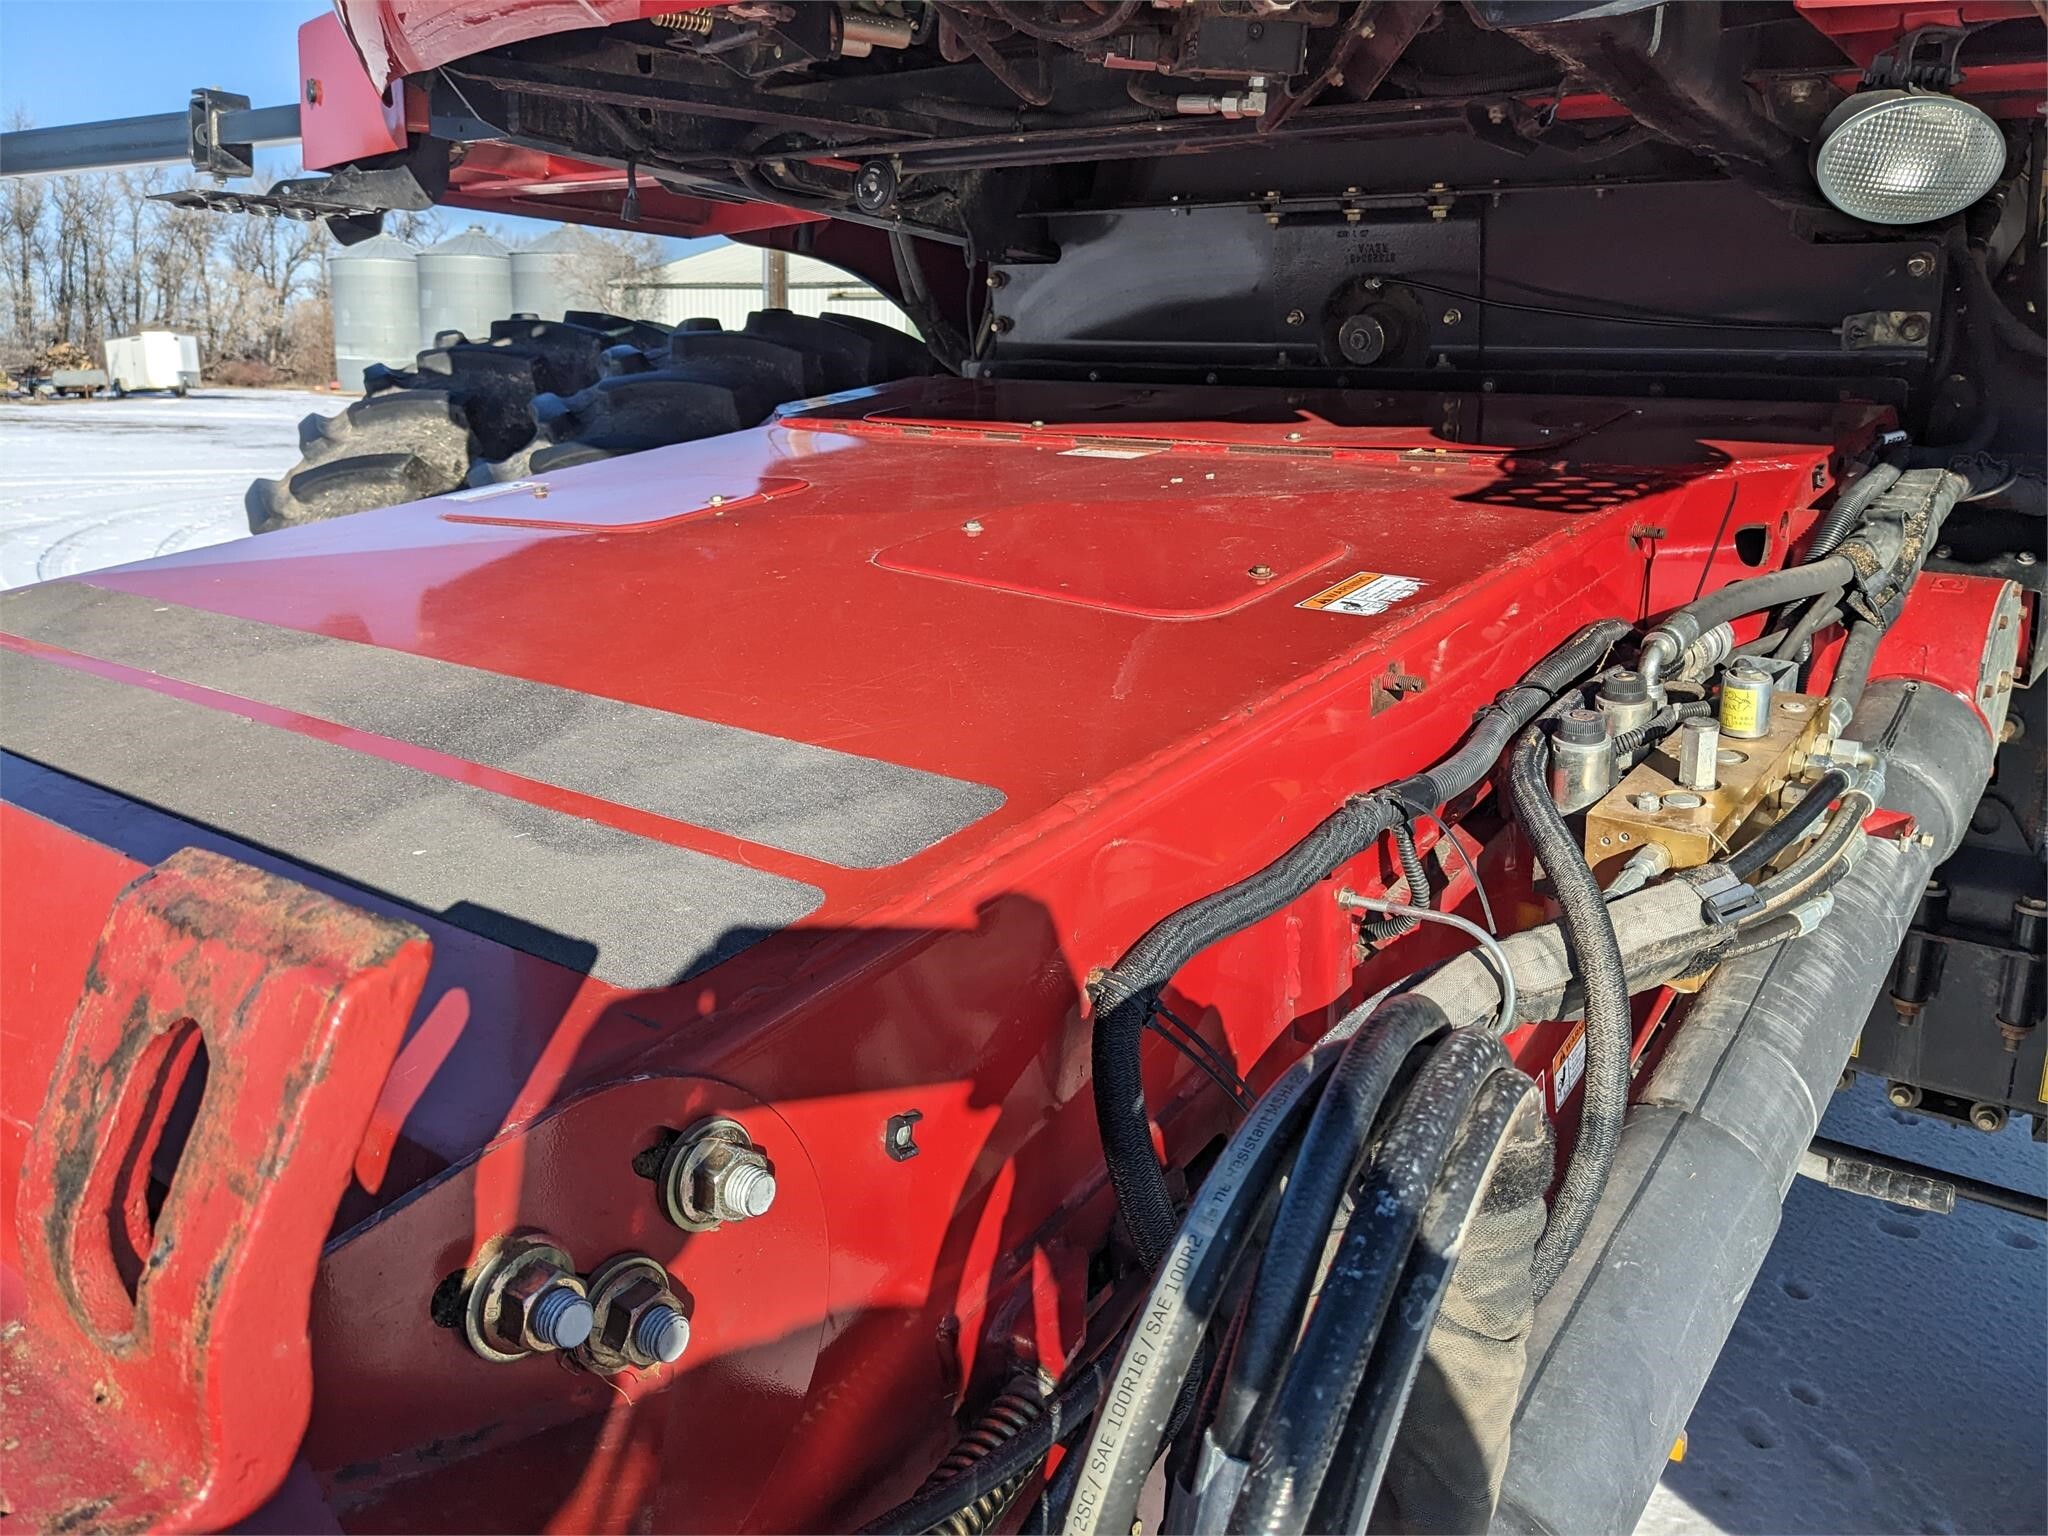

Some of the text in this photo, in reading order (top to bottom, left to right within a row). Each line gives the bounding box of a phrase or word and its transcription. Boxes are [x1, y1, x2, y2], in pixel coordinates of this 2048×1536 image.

[1072, 1489, 1096, 1532] 2SC
[1092, 1432, 1116, 1474] SAE
[1107, 1350, 1148, 1431] 100R16
[1146, 1296, 1173, 1335] SAE
[1163, 1233, 1204, 1296] 100R2
